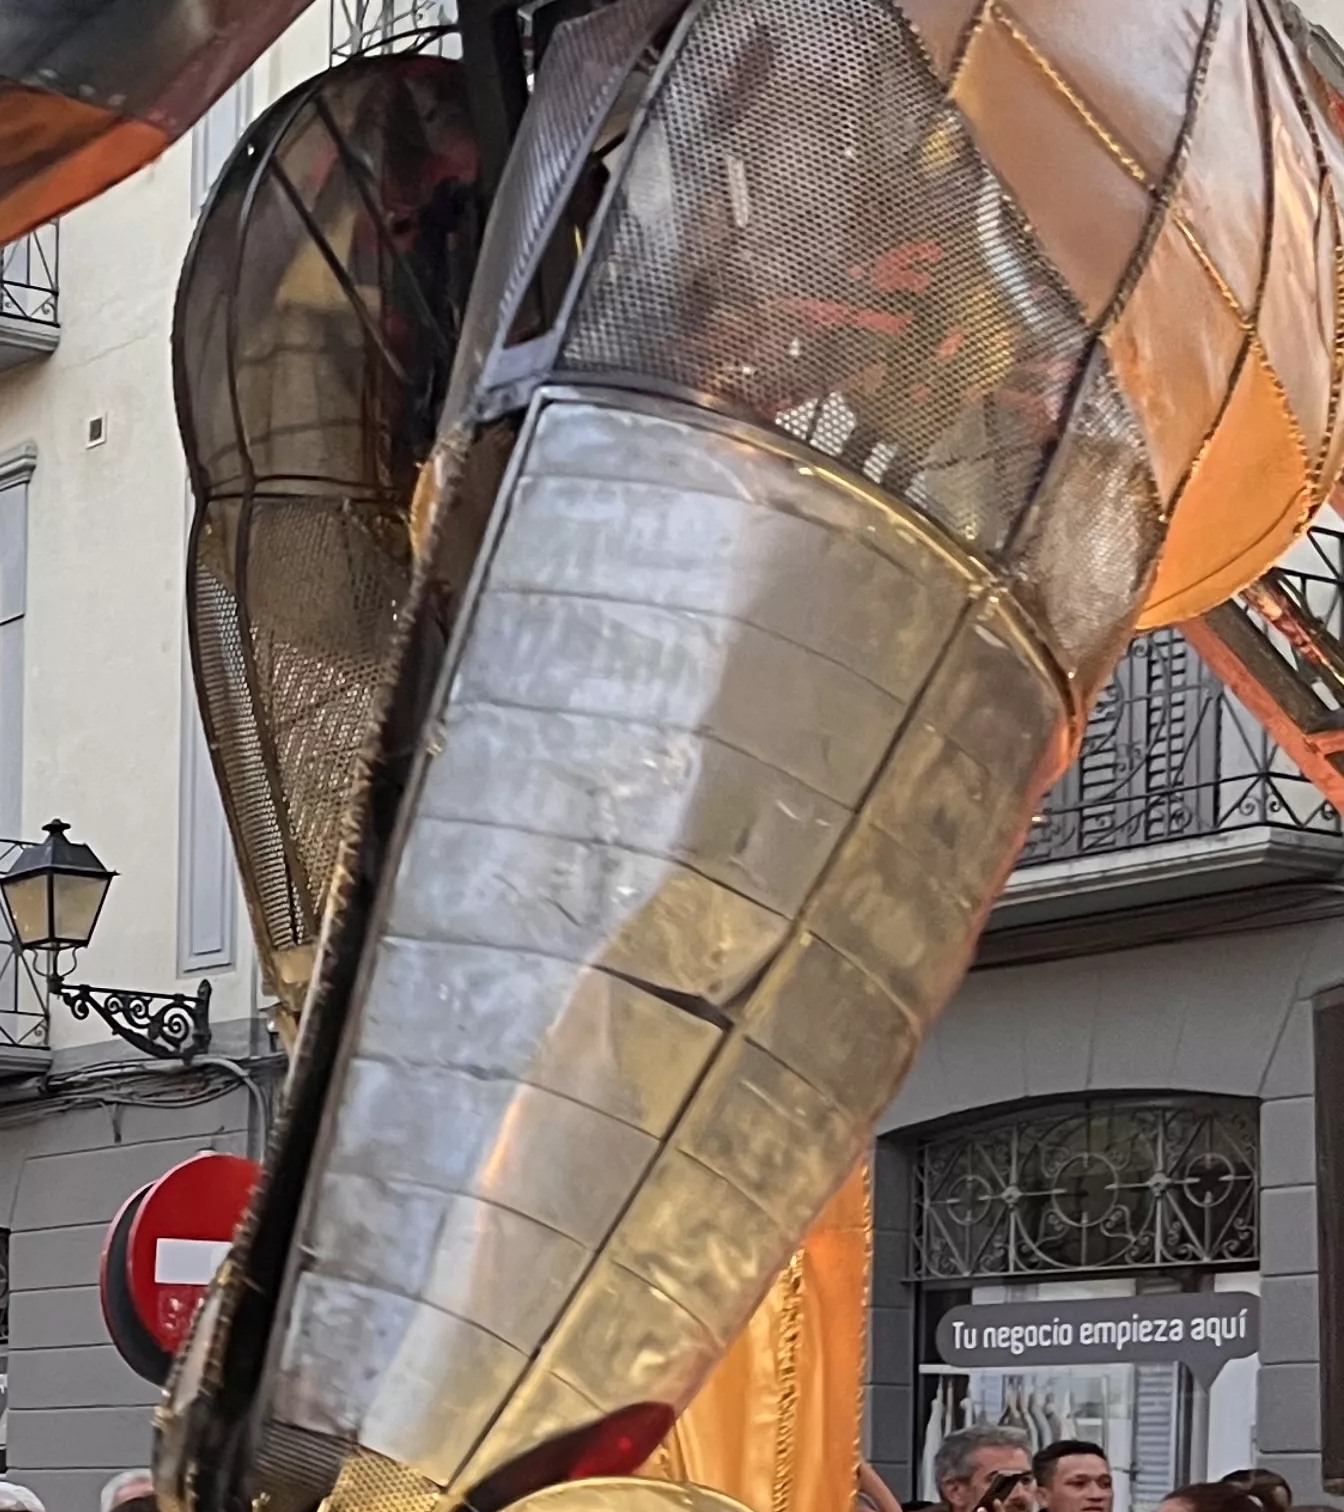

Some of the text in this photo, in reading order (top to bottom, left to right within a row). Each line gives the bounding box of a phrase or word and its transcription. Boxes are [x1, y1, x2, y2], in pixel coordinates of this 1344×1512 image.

[952, 1308, 1248, 1355] Tu negocio empieza aquí
